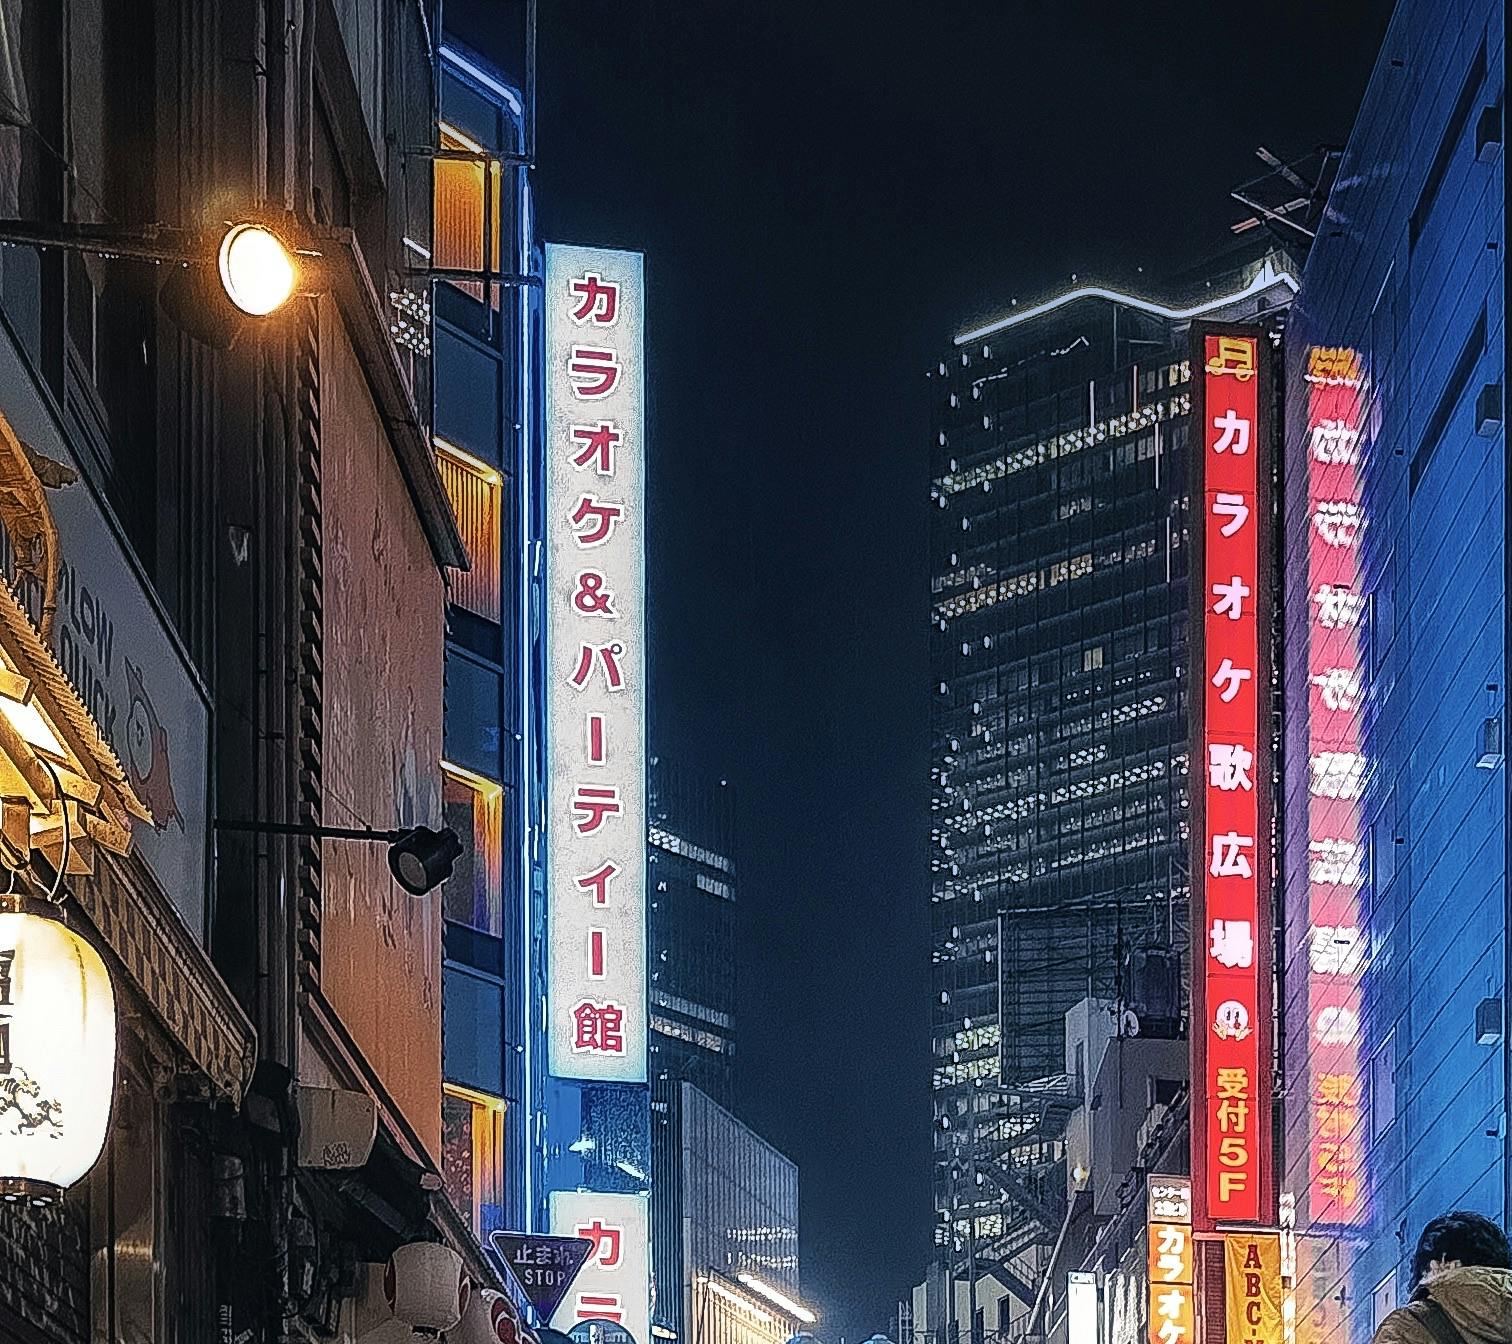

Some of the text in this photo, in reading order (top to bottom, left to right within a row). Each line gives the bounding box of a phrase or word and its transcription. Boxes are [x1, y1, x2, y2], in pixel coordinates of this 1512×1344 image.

[568, 273, 627, 1055] カラオケ&パーティー館
[1209, 409, 1254, 969] カラオケ歌広場
[1216, 1066, 1250, 1204] 受付5F
[513, 1243, 575, 1266] 止まれ
[524, 1268, 567, 1287] STOP
